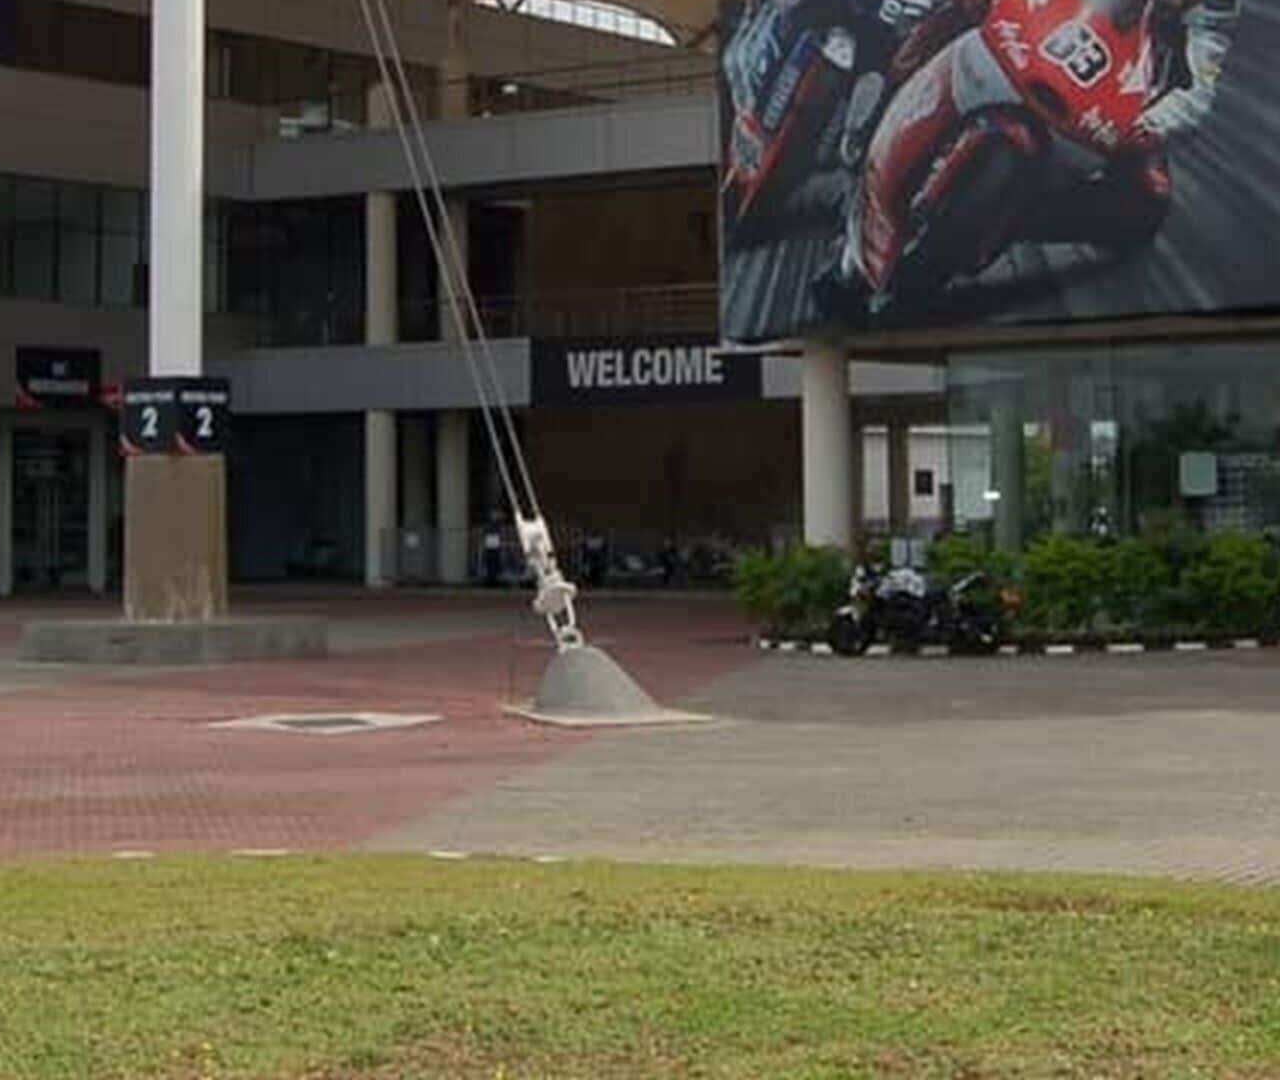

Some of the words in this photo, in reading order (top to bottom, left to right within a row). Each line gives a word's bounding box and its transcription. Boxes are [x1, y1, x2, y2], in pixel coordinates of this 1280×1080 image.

[567, 346, 724, 388] WELCOME
[140, 406, 159, 438] 2
[195, 406, 214, 438] 2
